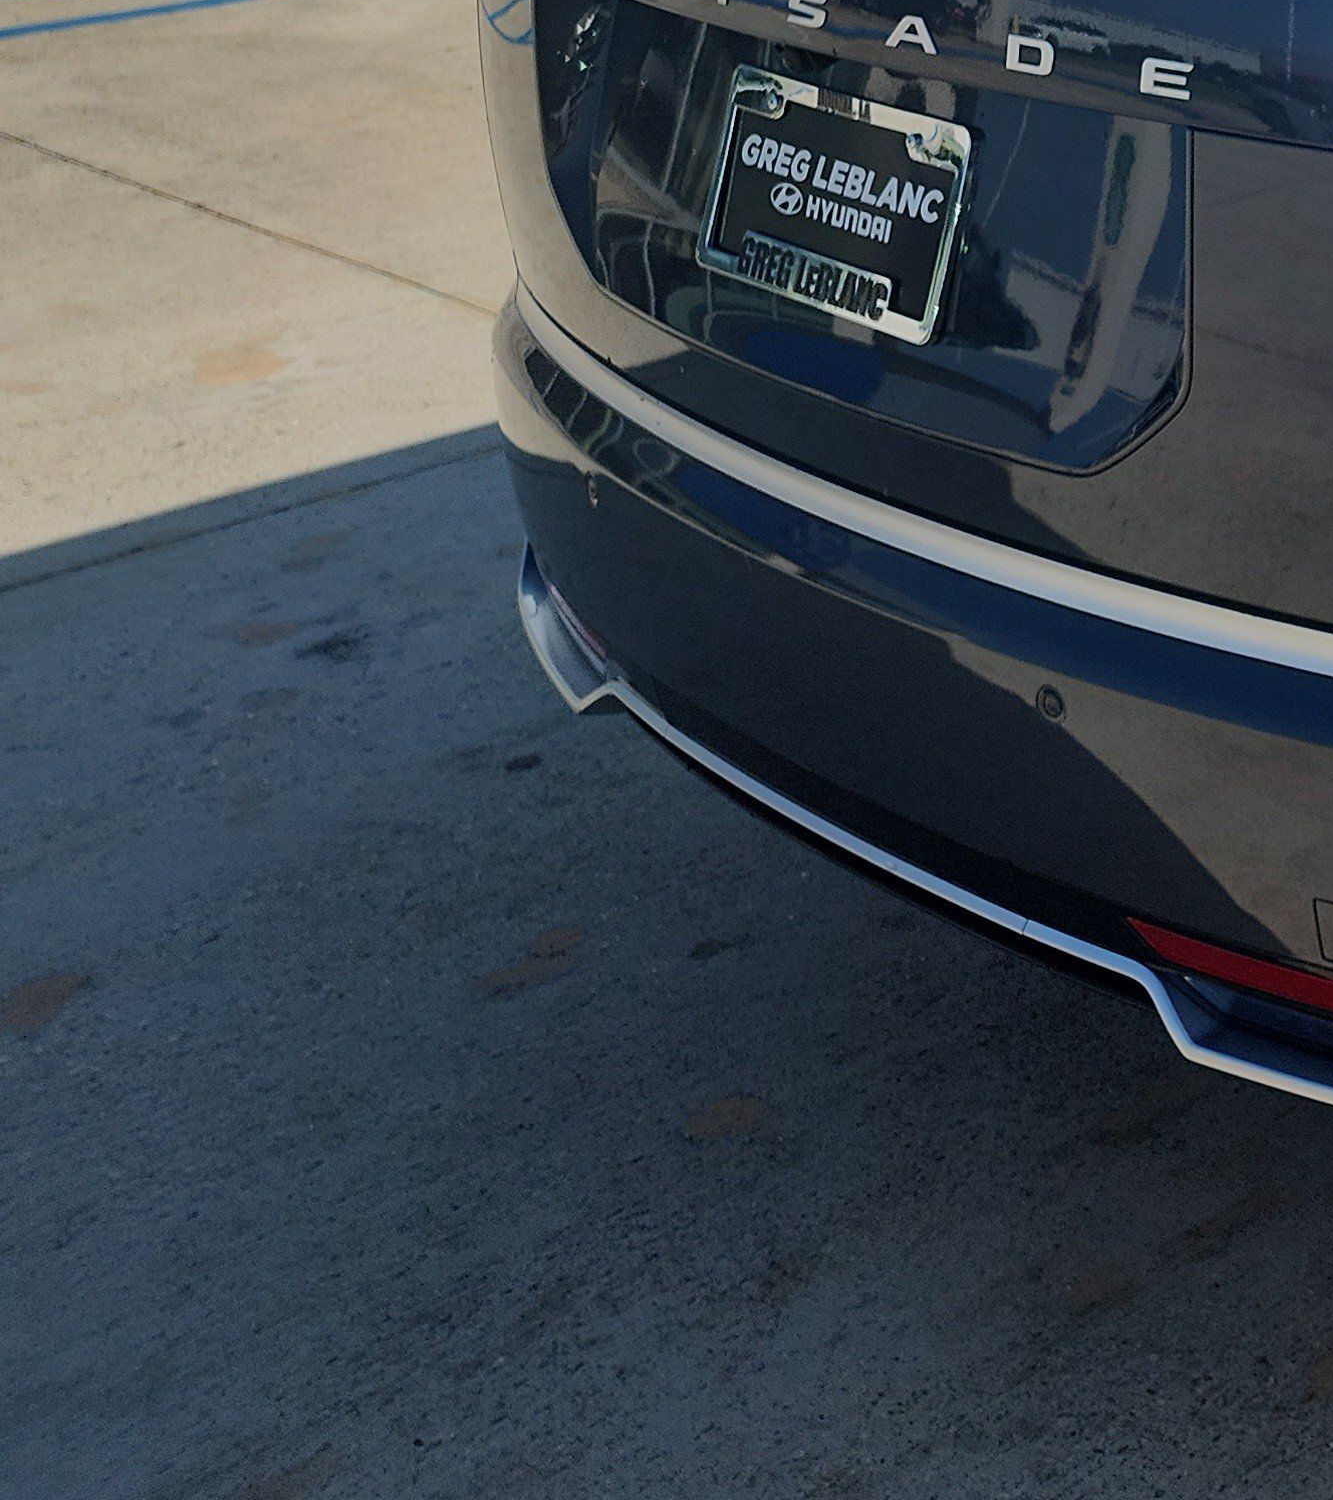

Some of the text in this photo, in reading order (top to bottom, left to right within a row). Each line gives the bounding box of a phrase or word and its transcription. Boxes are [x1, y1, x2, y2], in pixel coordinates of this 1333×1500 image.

[741, 133, 945, 224] GREG LEBLANC
[804, 194, 893, 244] HYUNDAI
[738, 237, 796, 290] GREG
